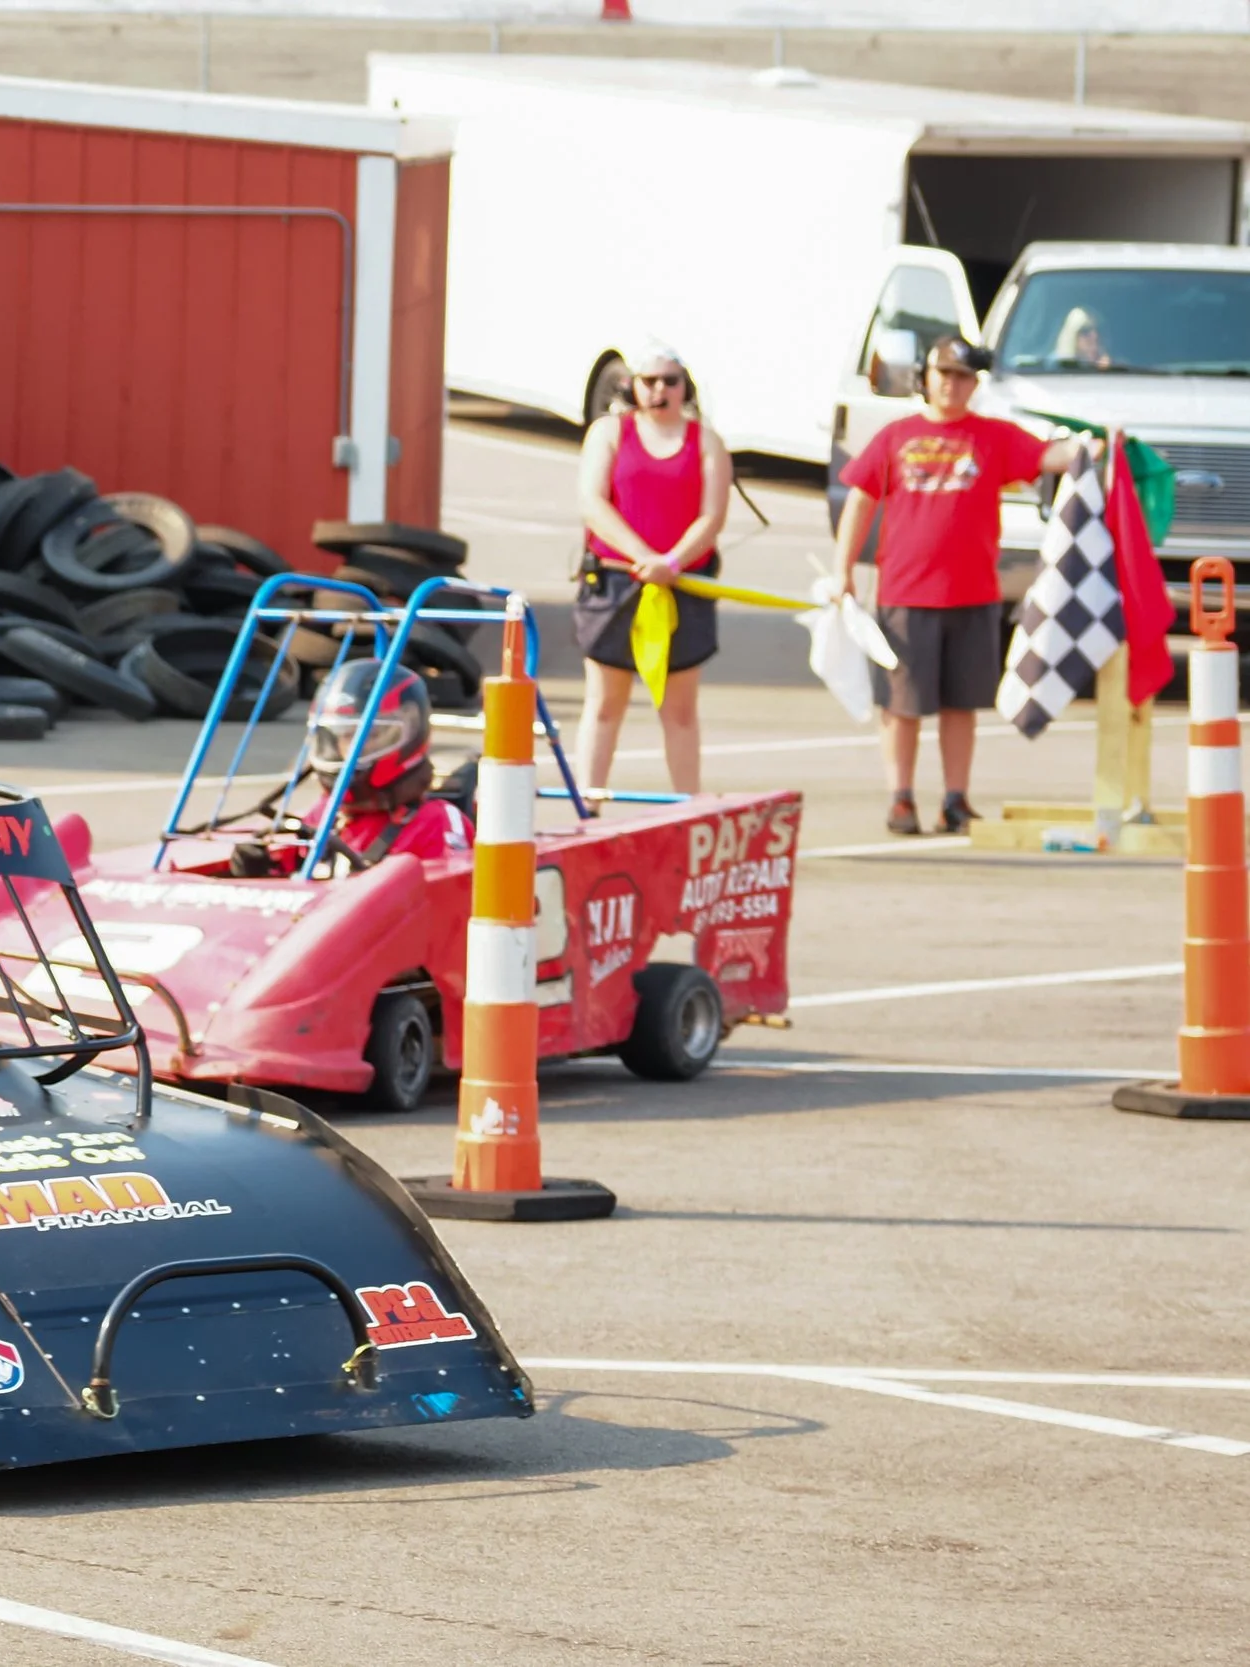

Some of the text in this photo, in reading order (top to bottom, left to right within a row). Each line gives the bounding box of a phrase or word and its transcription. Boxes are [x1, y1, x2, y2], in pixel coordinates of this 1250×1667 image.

[57, 1132, 135, 1147] Inn
[71, 1145, 146, 1164] Out
[36, 1200, 231, 1231] FINANCIAL
